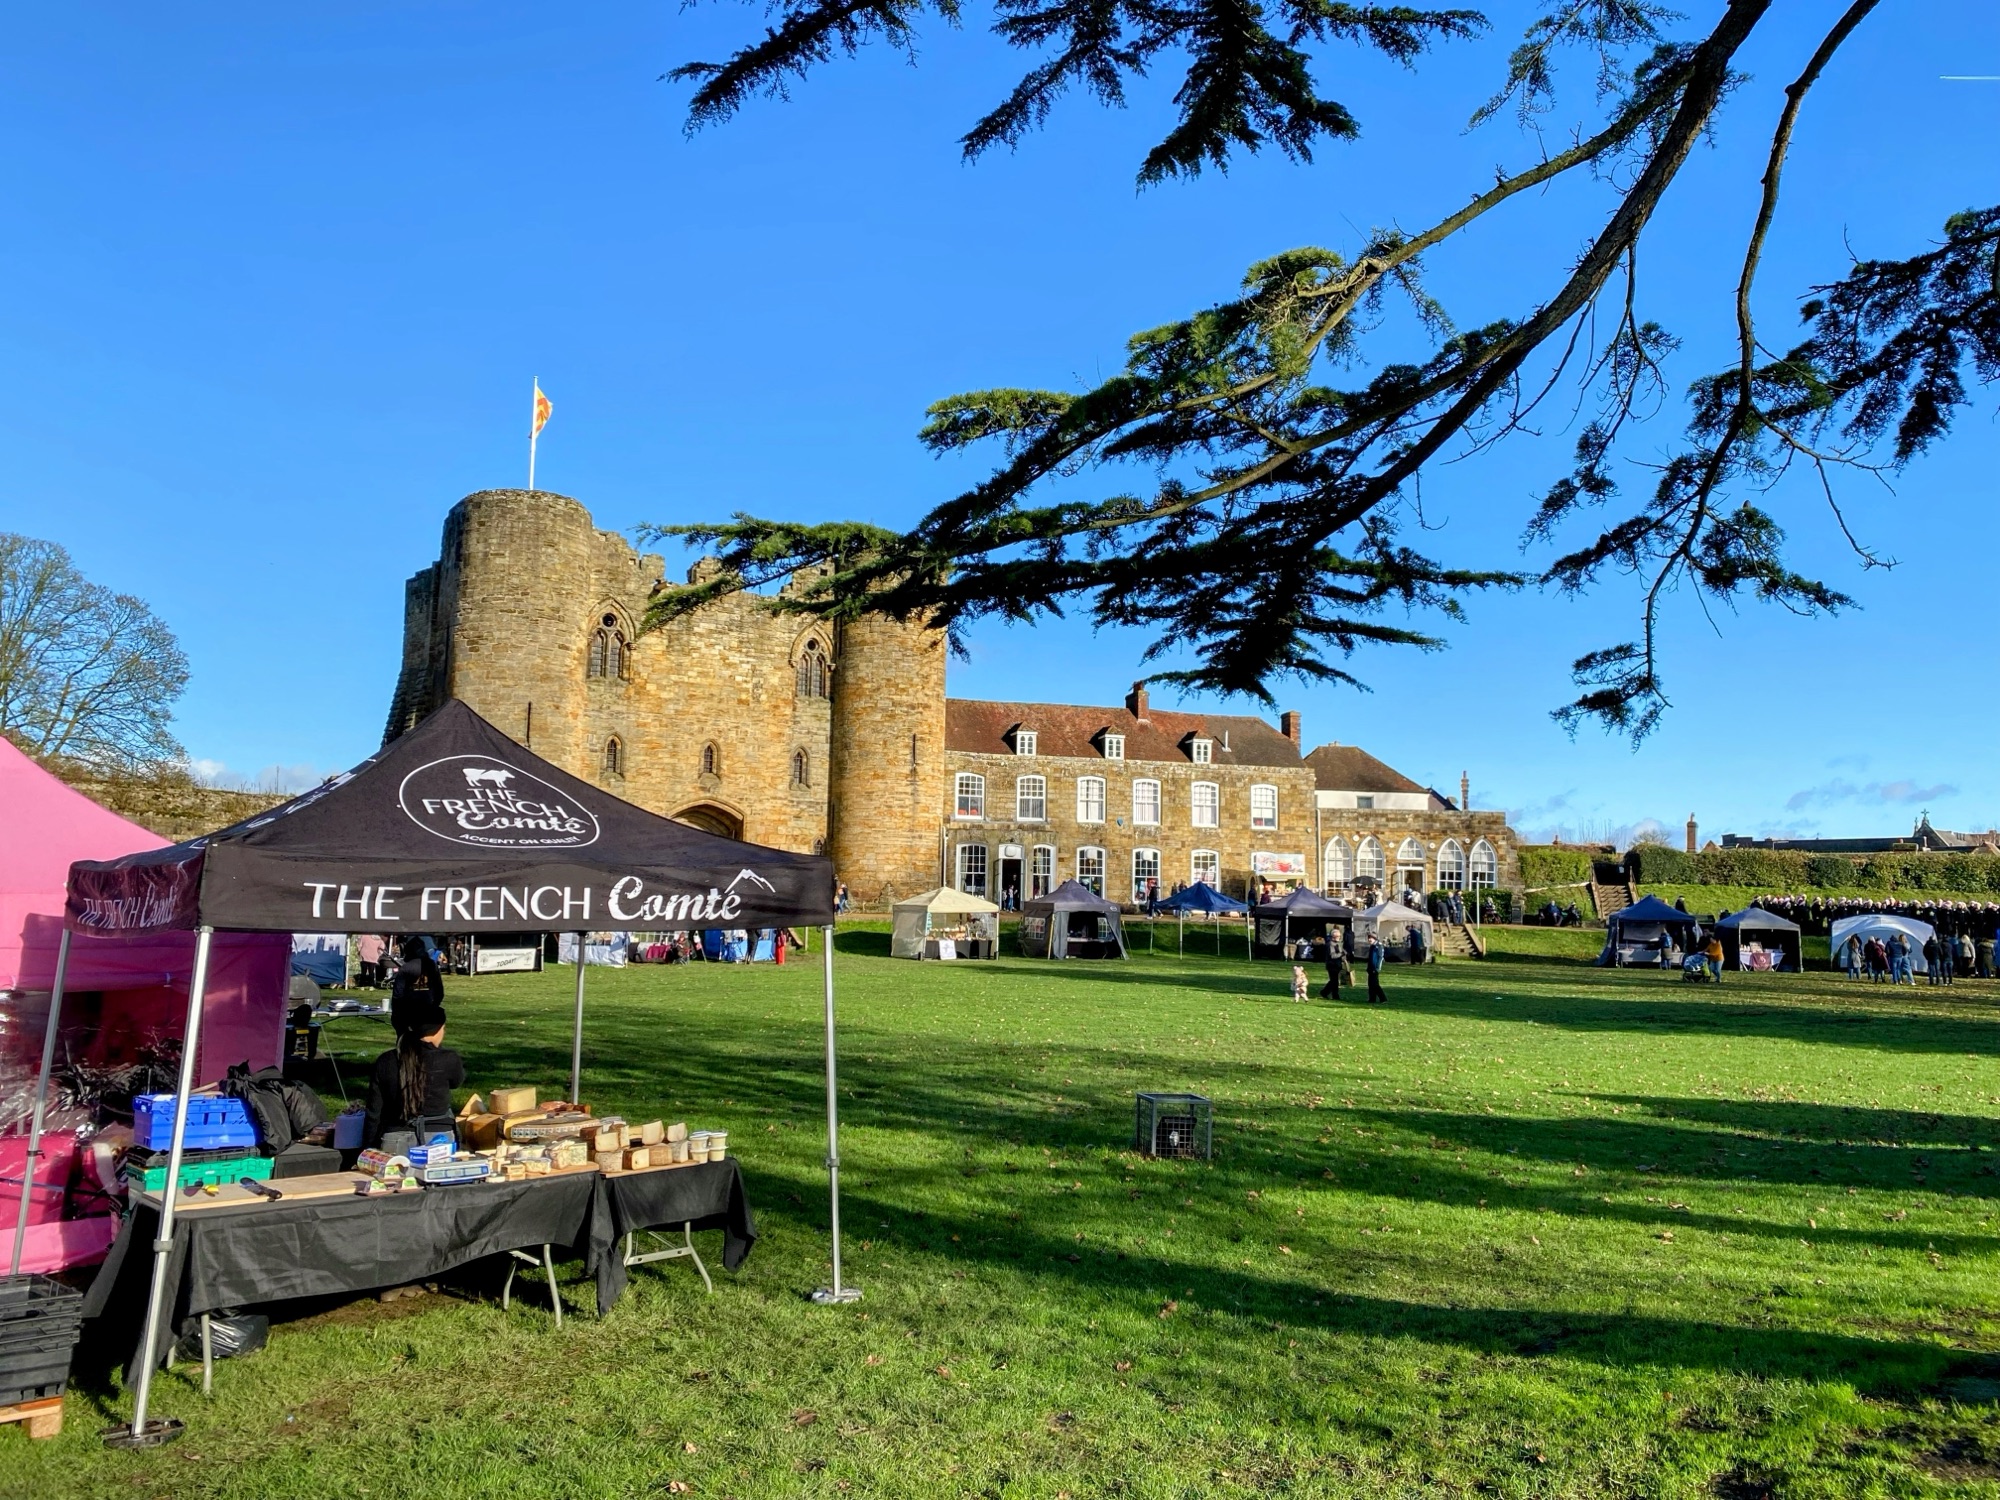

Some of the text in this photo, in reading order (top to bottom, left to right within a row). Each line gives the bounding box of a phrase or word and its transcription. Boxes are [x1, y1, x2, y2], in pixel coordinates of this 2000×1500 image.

[466, 788, 518, 801] THE
[421, 799, 569, 819] FRENCH
[458, 833, 515, 845] ACCENT
[540, 836, 581, 845] QUALITY
[303, 875, 742, 922] THE FRENCH Comté
[77, 897, 102, 926] THE
[99, 896, 141, 930] FRENCH
